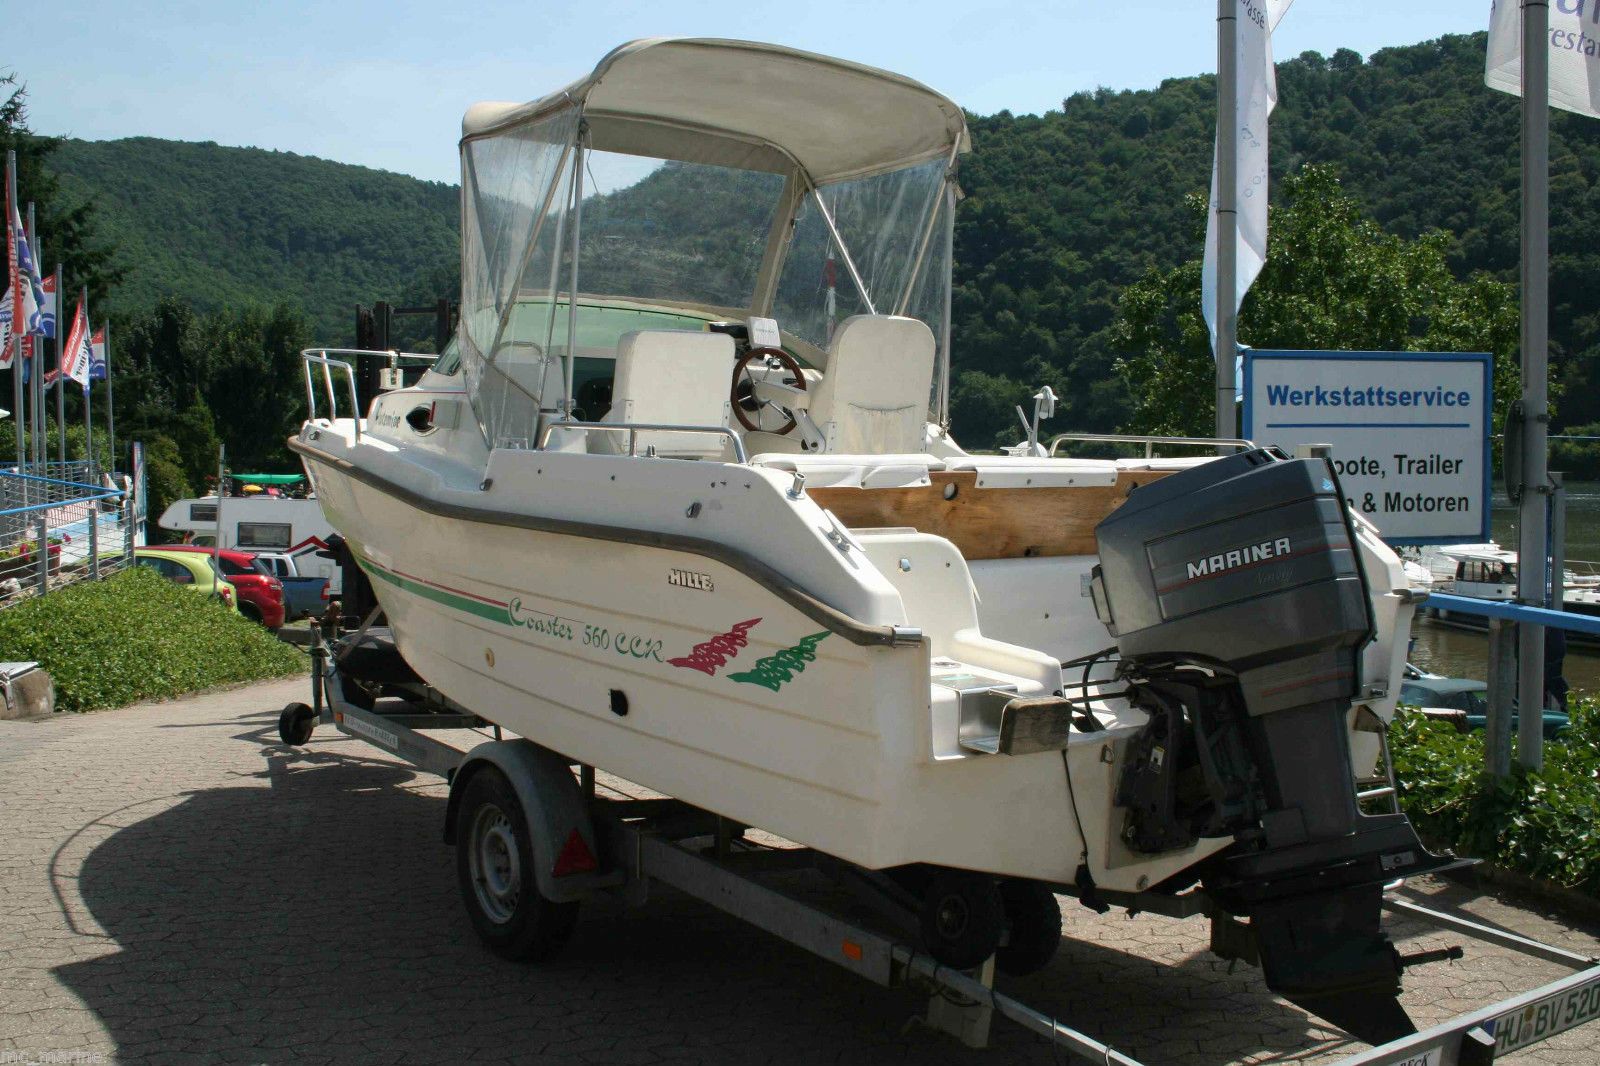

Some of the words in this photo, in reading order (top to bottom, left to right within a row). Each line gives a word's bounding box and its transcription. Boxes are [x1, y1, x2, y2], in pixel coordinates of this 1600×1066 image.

[1549, 27, 1600, 59] resta
[1266, 385, 1471, 407] Werkstattservice
[1394, 454, 1464, 475] Trailer
[1362, 492, 1377, 513] &
[1384, 491, 1469, 513] Motoren
[1186, 536, 1292, 580] MARINER
[668, 568, 714, 592] HILLE
[508, 596, 574, 641] Coaster
[582, 624, 610, 650] 560
[1495, 1013, 1523, 1050] HU
[1535, 997, 1564, 1036] BV
